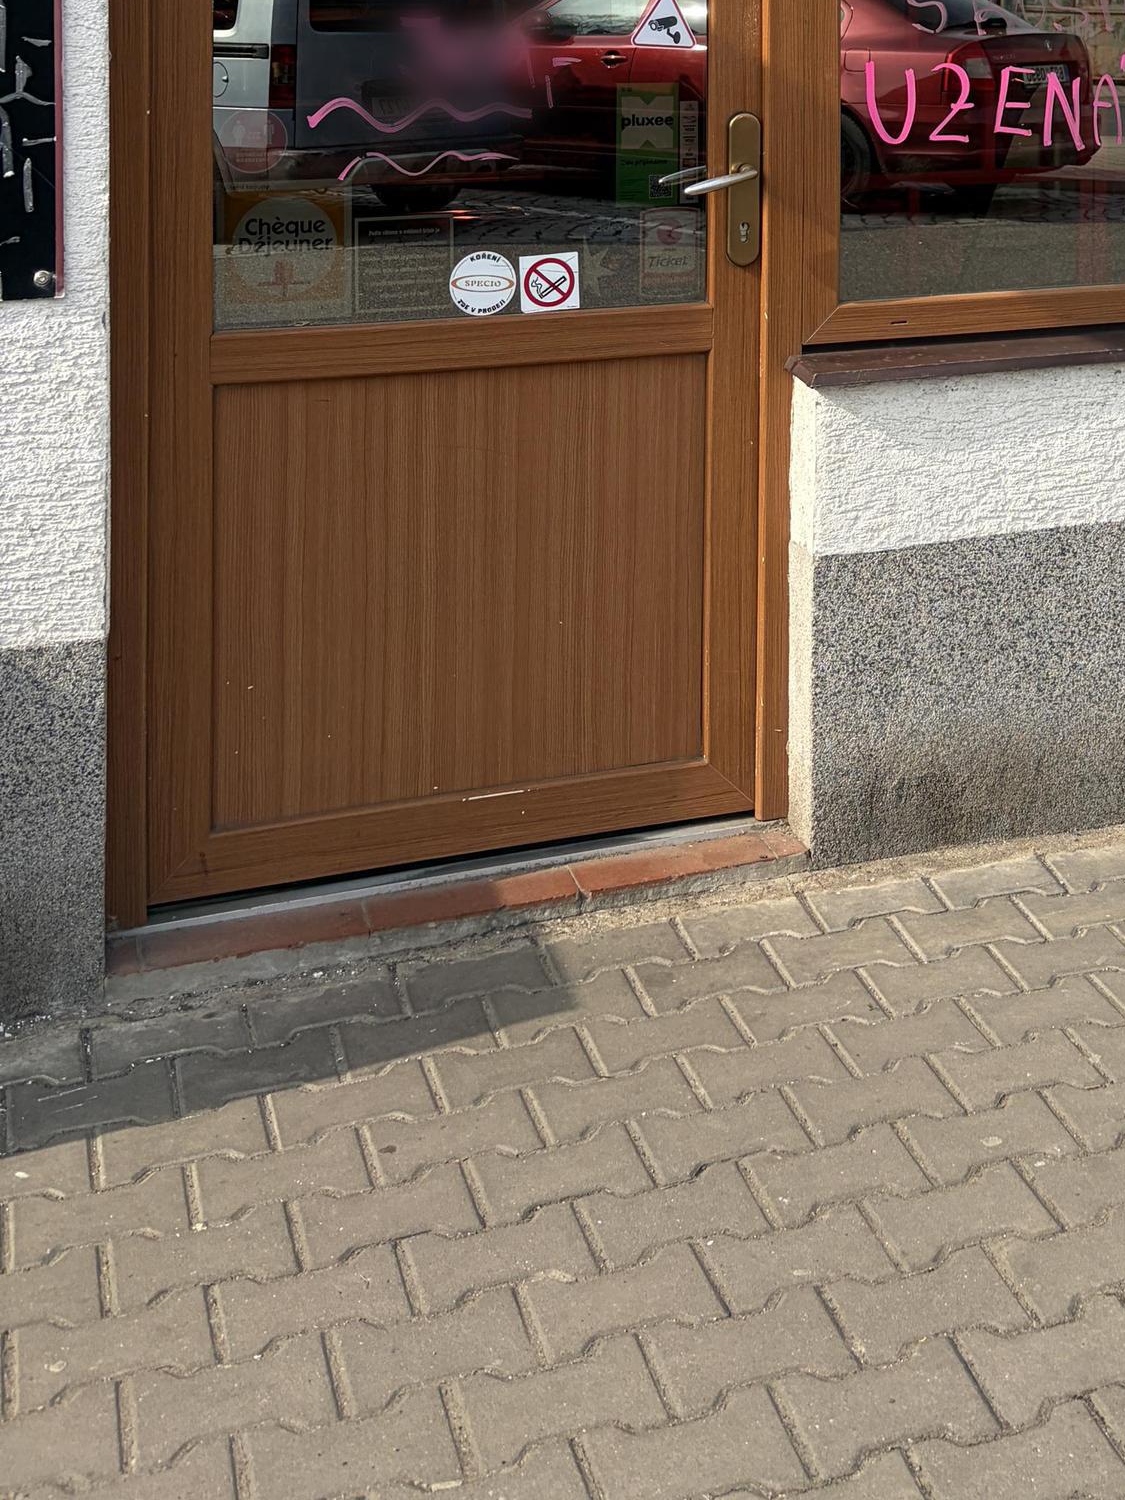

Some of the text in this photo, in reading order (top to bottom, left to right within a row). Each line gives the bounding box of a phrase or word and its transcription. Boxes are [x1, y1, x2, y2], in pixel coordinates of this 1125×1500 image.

[622, 114, 673, 130] pluxee
[245, 217, 325, 237] Chèque
[238, 236, 333, 256] Déjeuner
[470, 252, 502, 263] KOŘENÍ
